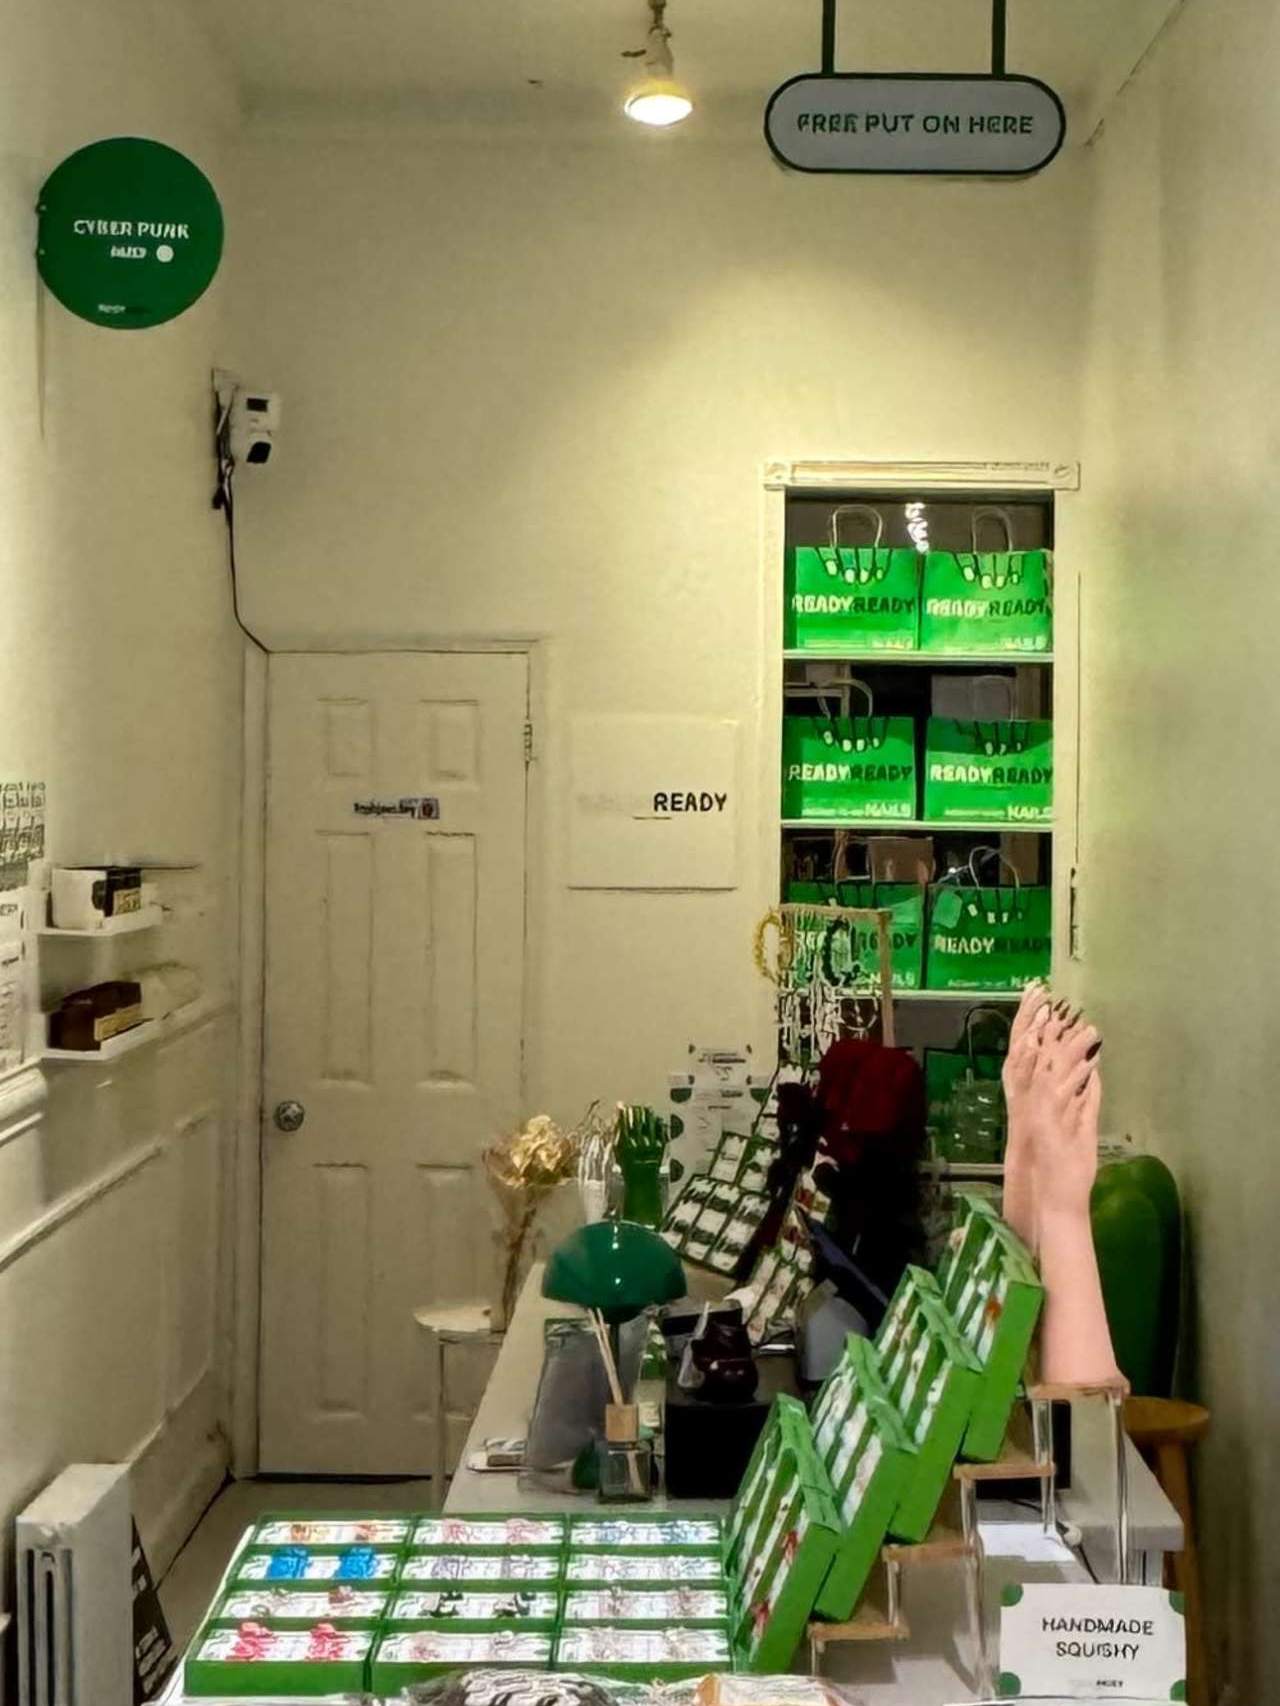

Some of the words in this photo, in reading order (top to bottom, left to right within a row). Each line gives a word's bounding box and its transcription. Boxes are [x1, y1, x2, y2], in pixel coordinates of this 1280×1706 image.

[797, 113, 859, 133] FREE
[865, 112, 914, 133] PUT
[923, 115, 960, 133] ON
[969, 116, 1033, 134] HERE
[73, 219, 133, 236] CYBER
[137, 221, 190, 239] PUNK
[653, 792, 728, 813] READY
[1042, 1617, 1155, 1636] HANDMADE
[1056, 1641, 1140, 1661] SQUISHY
